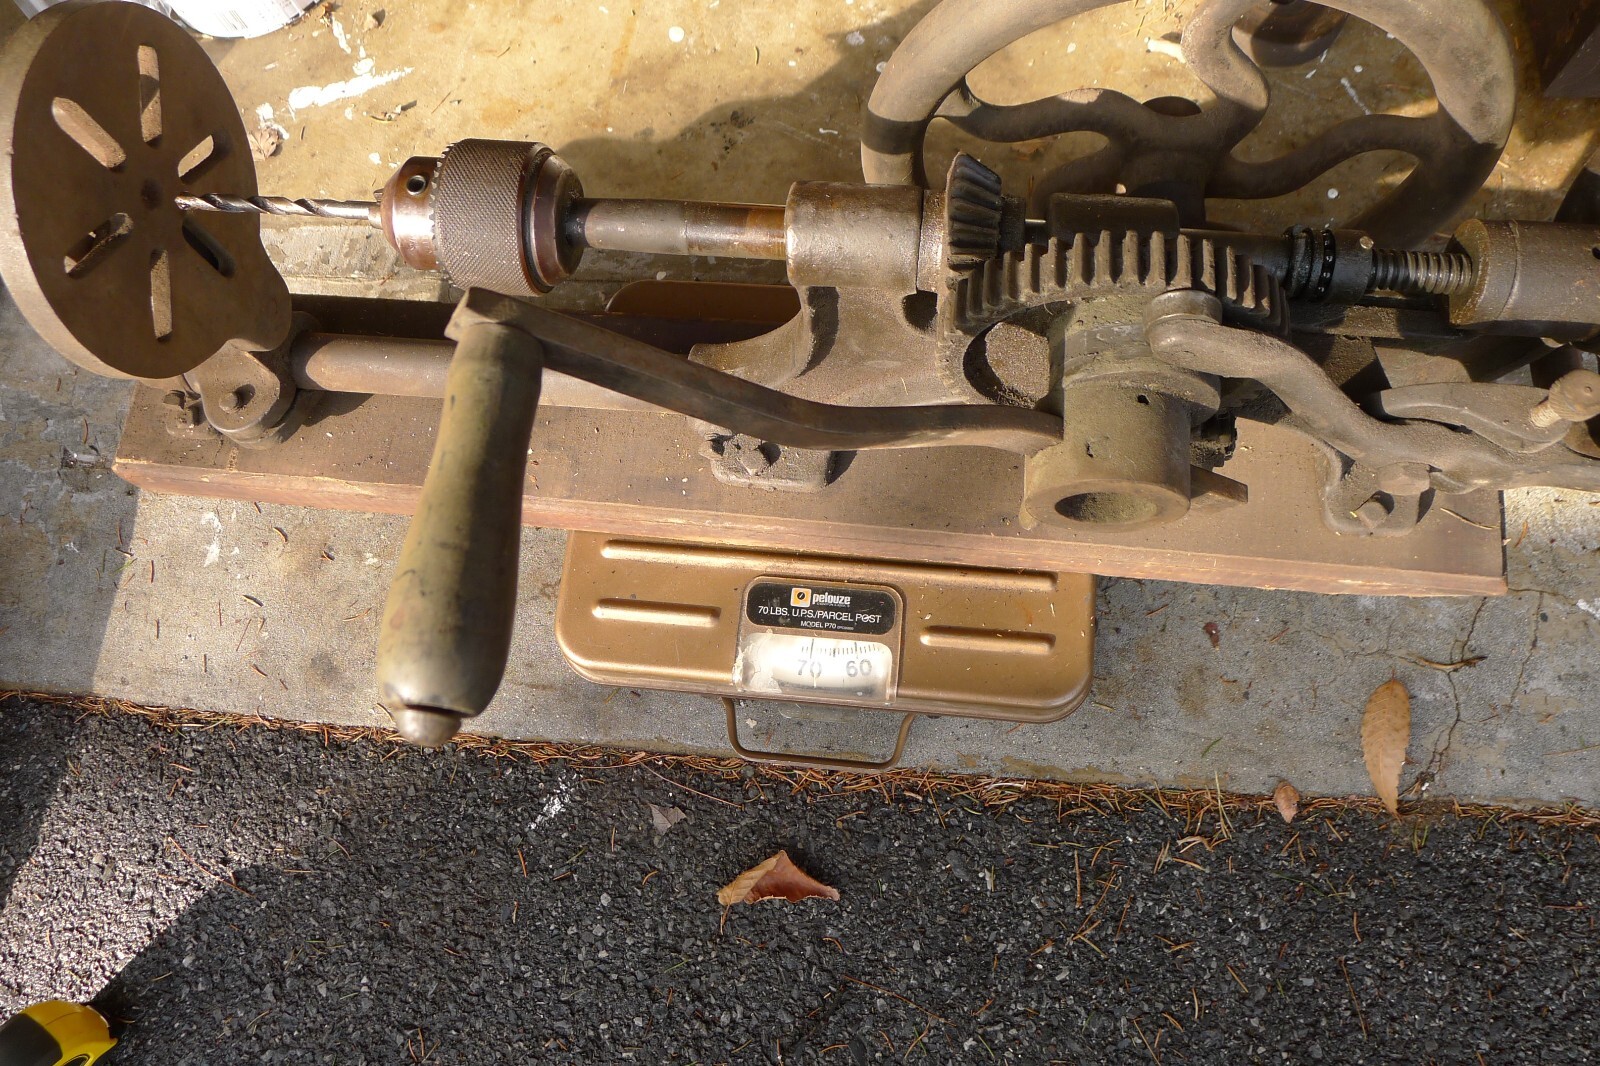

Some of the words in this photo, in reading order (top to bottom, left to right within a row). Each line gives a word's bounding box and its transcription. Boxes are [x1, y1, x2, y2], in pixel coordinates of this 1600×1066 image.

[812, 592, 851, 605] pelouze
[758, 605, 769, 615] 70
[770, 606, 790, 617] LBS.
[855, 613, 882, 624] POST
[800, 620, 824, 629] MODEL
[824, 622, 837, 630] P70
[797, 659, 822, 678] 70
[846, 658, 872, 678] 60
